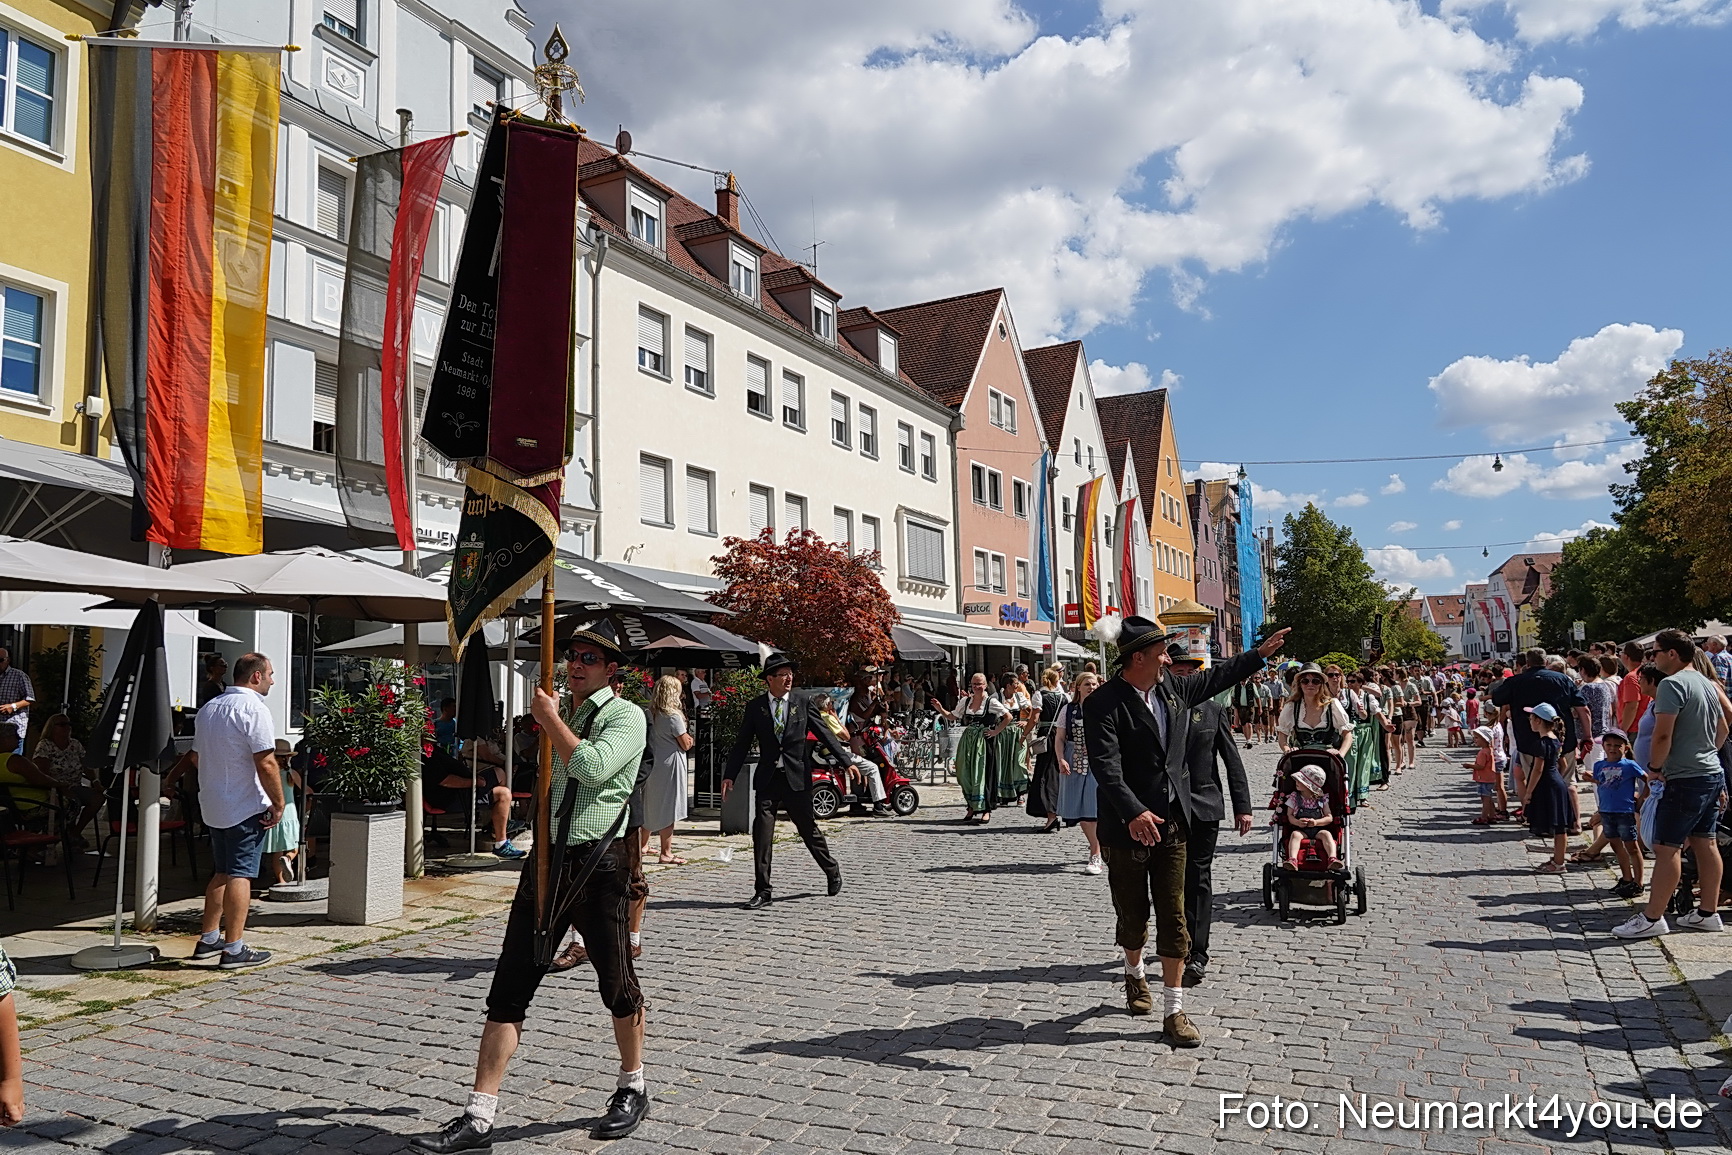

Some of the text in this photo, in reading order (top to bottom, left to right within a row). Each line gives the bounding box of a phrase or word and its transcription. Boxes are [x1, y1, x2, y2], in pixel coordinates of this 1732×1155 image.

[458, 294, 477, 314] Den
[460, 319, 477, 333] zur
[461, 351, 484, 369] Stadt
[456, 384, 477, 400] 1988
